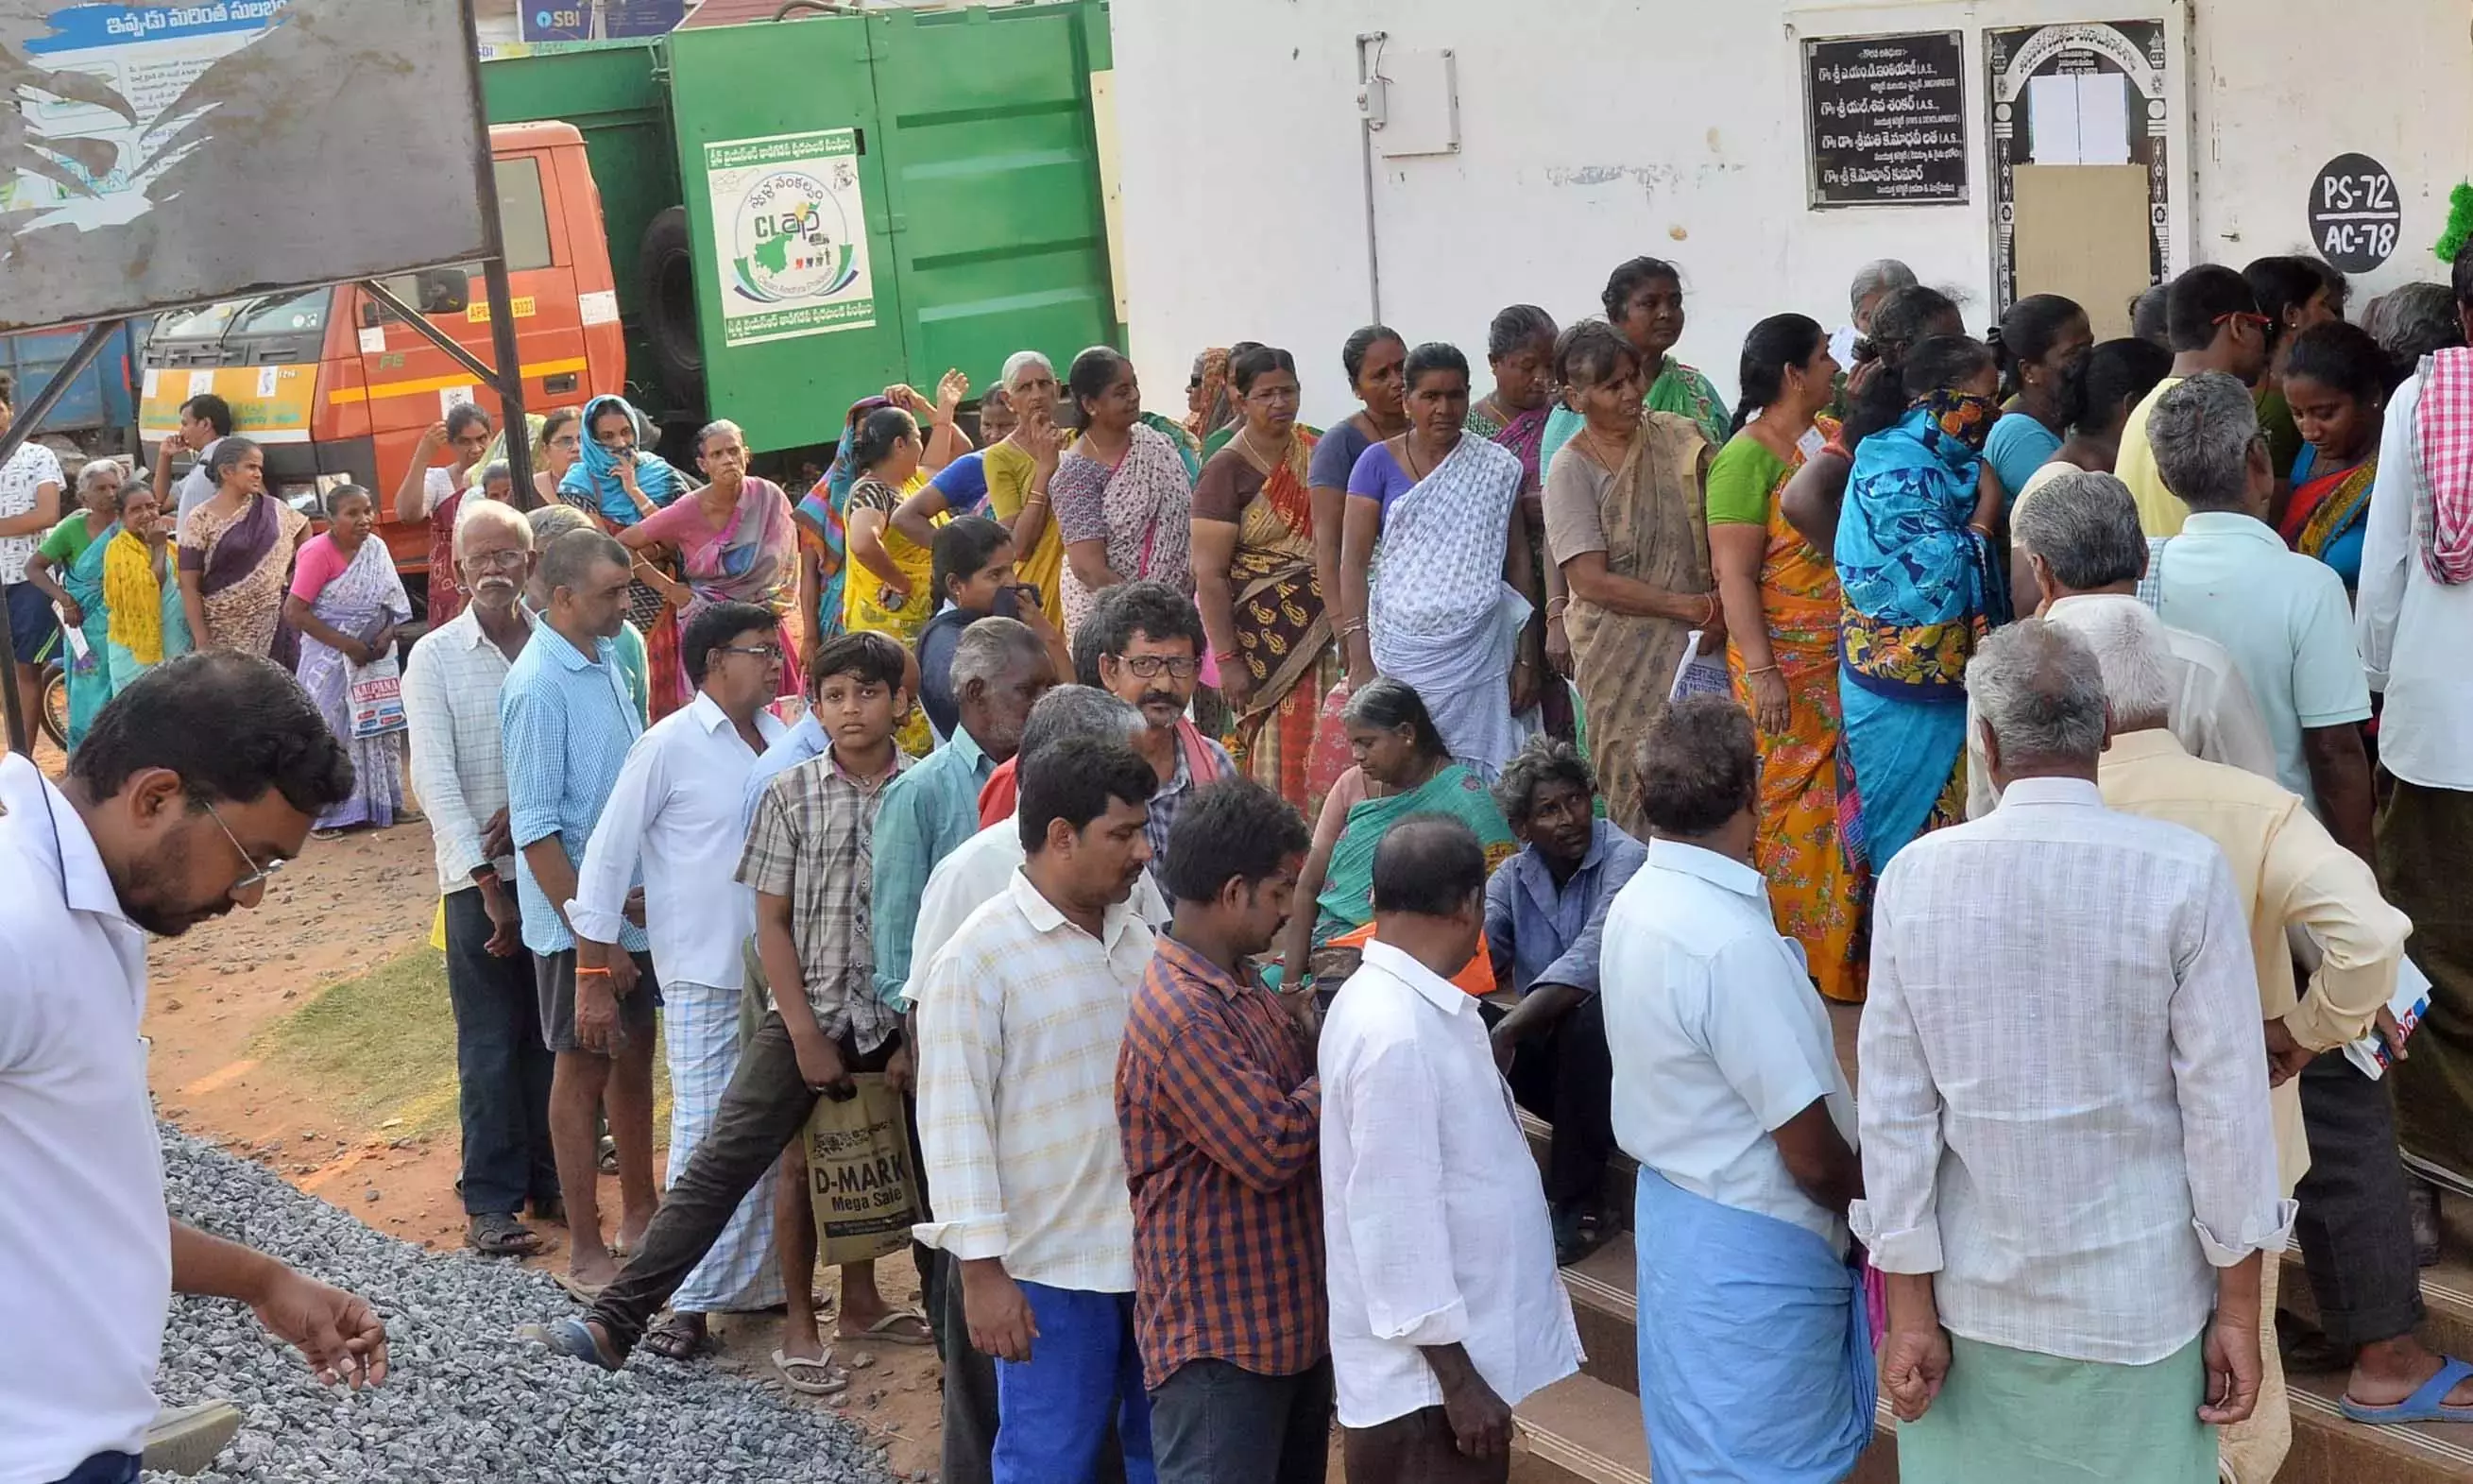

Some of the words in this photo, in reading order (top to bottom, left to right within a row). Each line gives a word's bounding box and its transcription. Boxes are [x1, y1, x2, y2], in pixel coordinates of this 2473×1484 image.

[106, 13, 166, 37] ఇప్పుడు
[169, 5, 228, 26] మరింత
[554, 11, 580, 27] SBI
[1892, 164, 1923, 181] కుమార్
[2325, 175, 2393, 209] PS-72
[2325, 223, 2396, 258] AC-78
[831, 1195, 869, 1212] Mega
[873, 1186, 903, 1207] Sale
